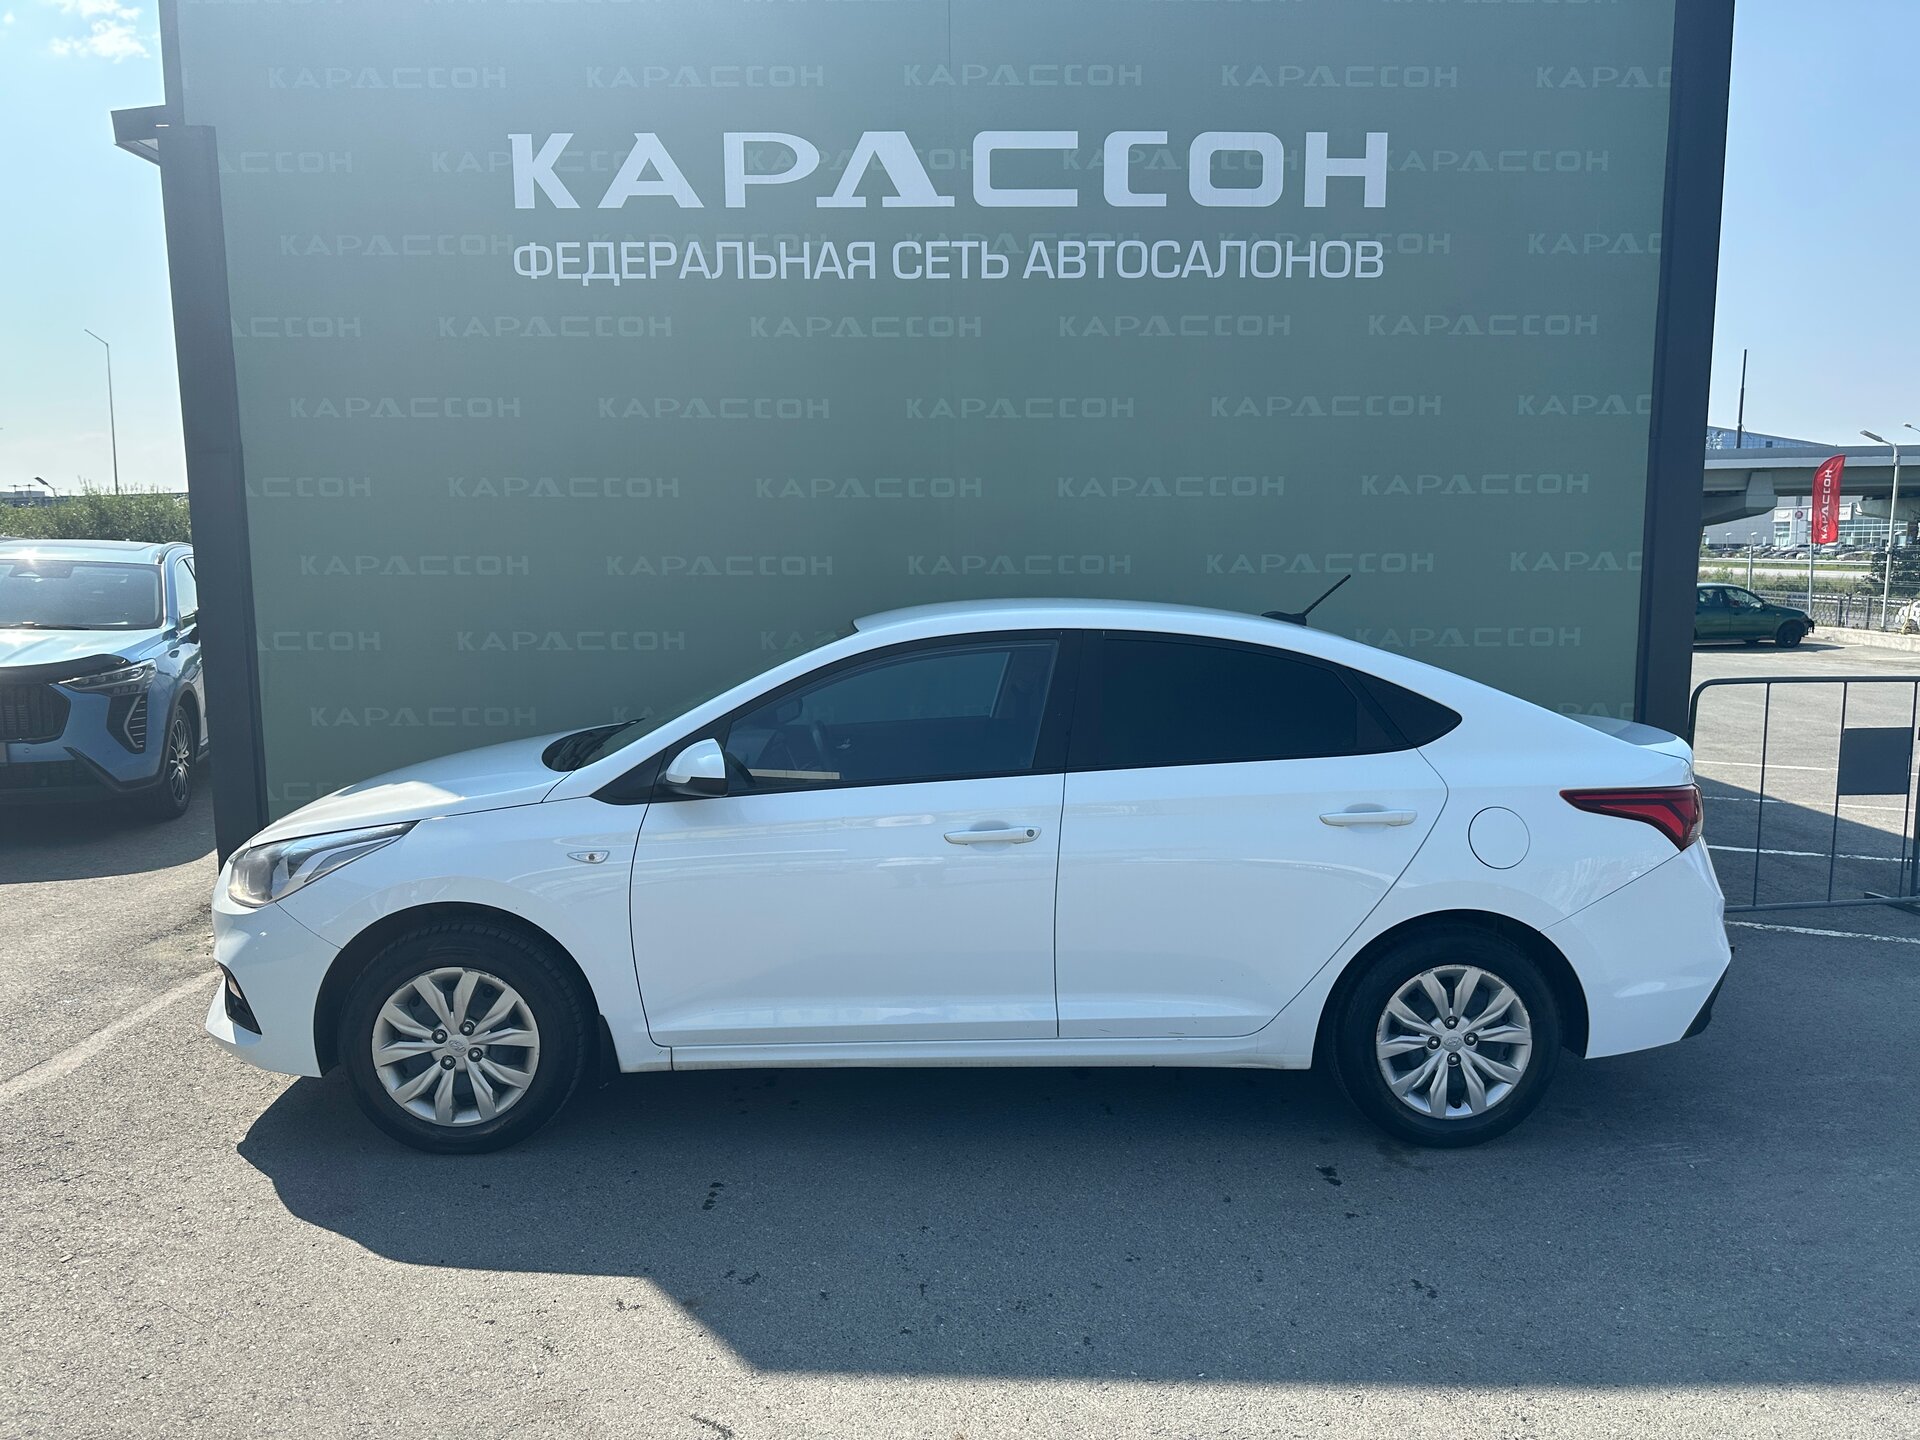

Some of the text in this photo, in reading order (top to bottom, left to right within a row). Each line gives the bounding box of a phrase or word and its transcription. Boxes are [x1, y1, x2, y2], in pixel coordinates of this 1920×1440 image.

[513, 240, 1384, 287] ФЕДЕРАЛЬНАЯ СЕТЬ АВТОСАЛОНОВ
